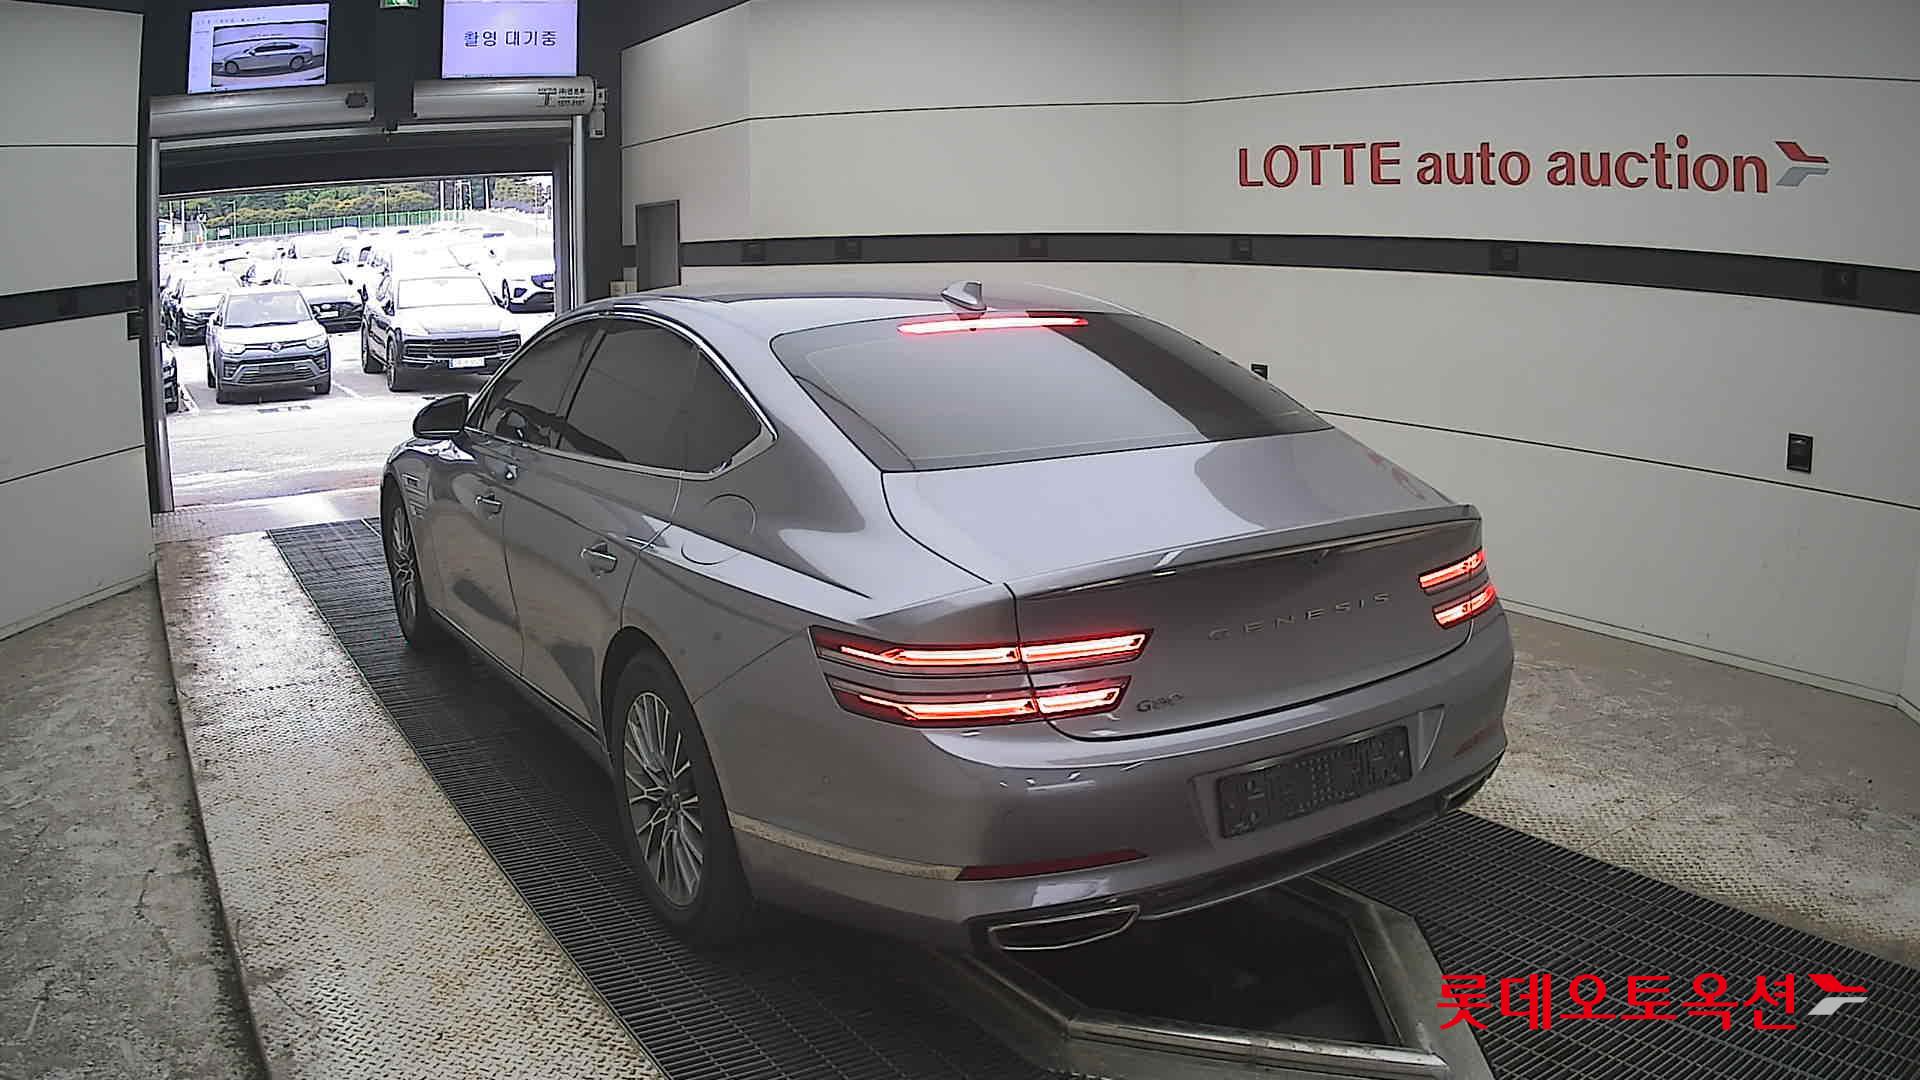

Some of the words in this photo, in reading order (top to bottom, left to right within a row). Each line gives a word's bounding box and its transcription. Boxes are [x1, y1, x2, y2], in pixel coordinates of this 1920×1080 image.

[505, 30, 557, 47] 대기중
[1239, 141, 1401, 188] LOTTE
[1416, 141, 1531, 186] auto
[1546, 133, 1769, 194] auction
[1208, 591, 1391, 641] GENESIS
